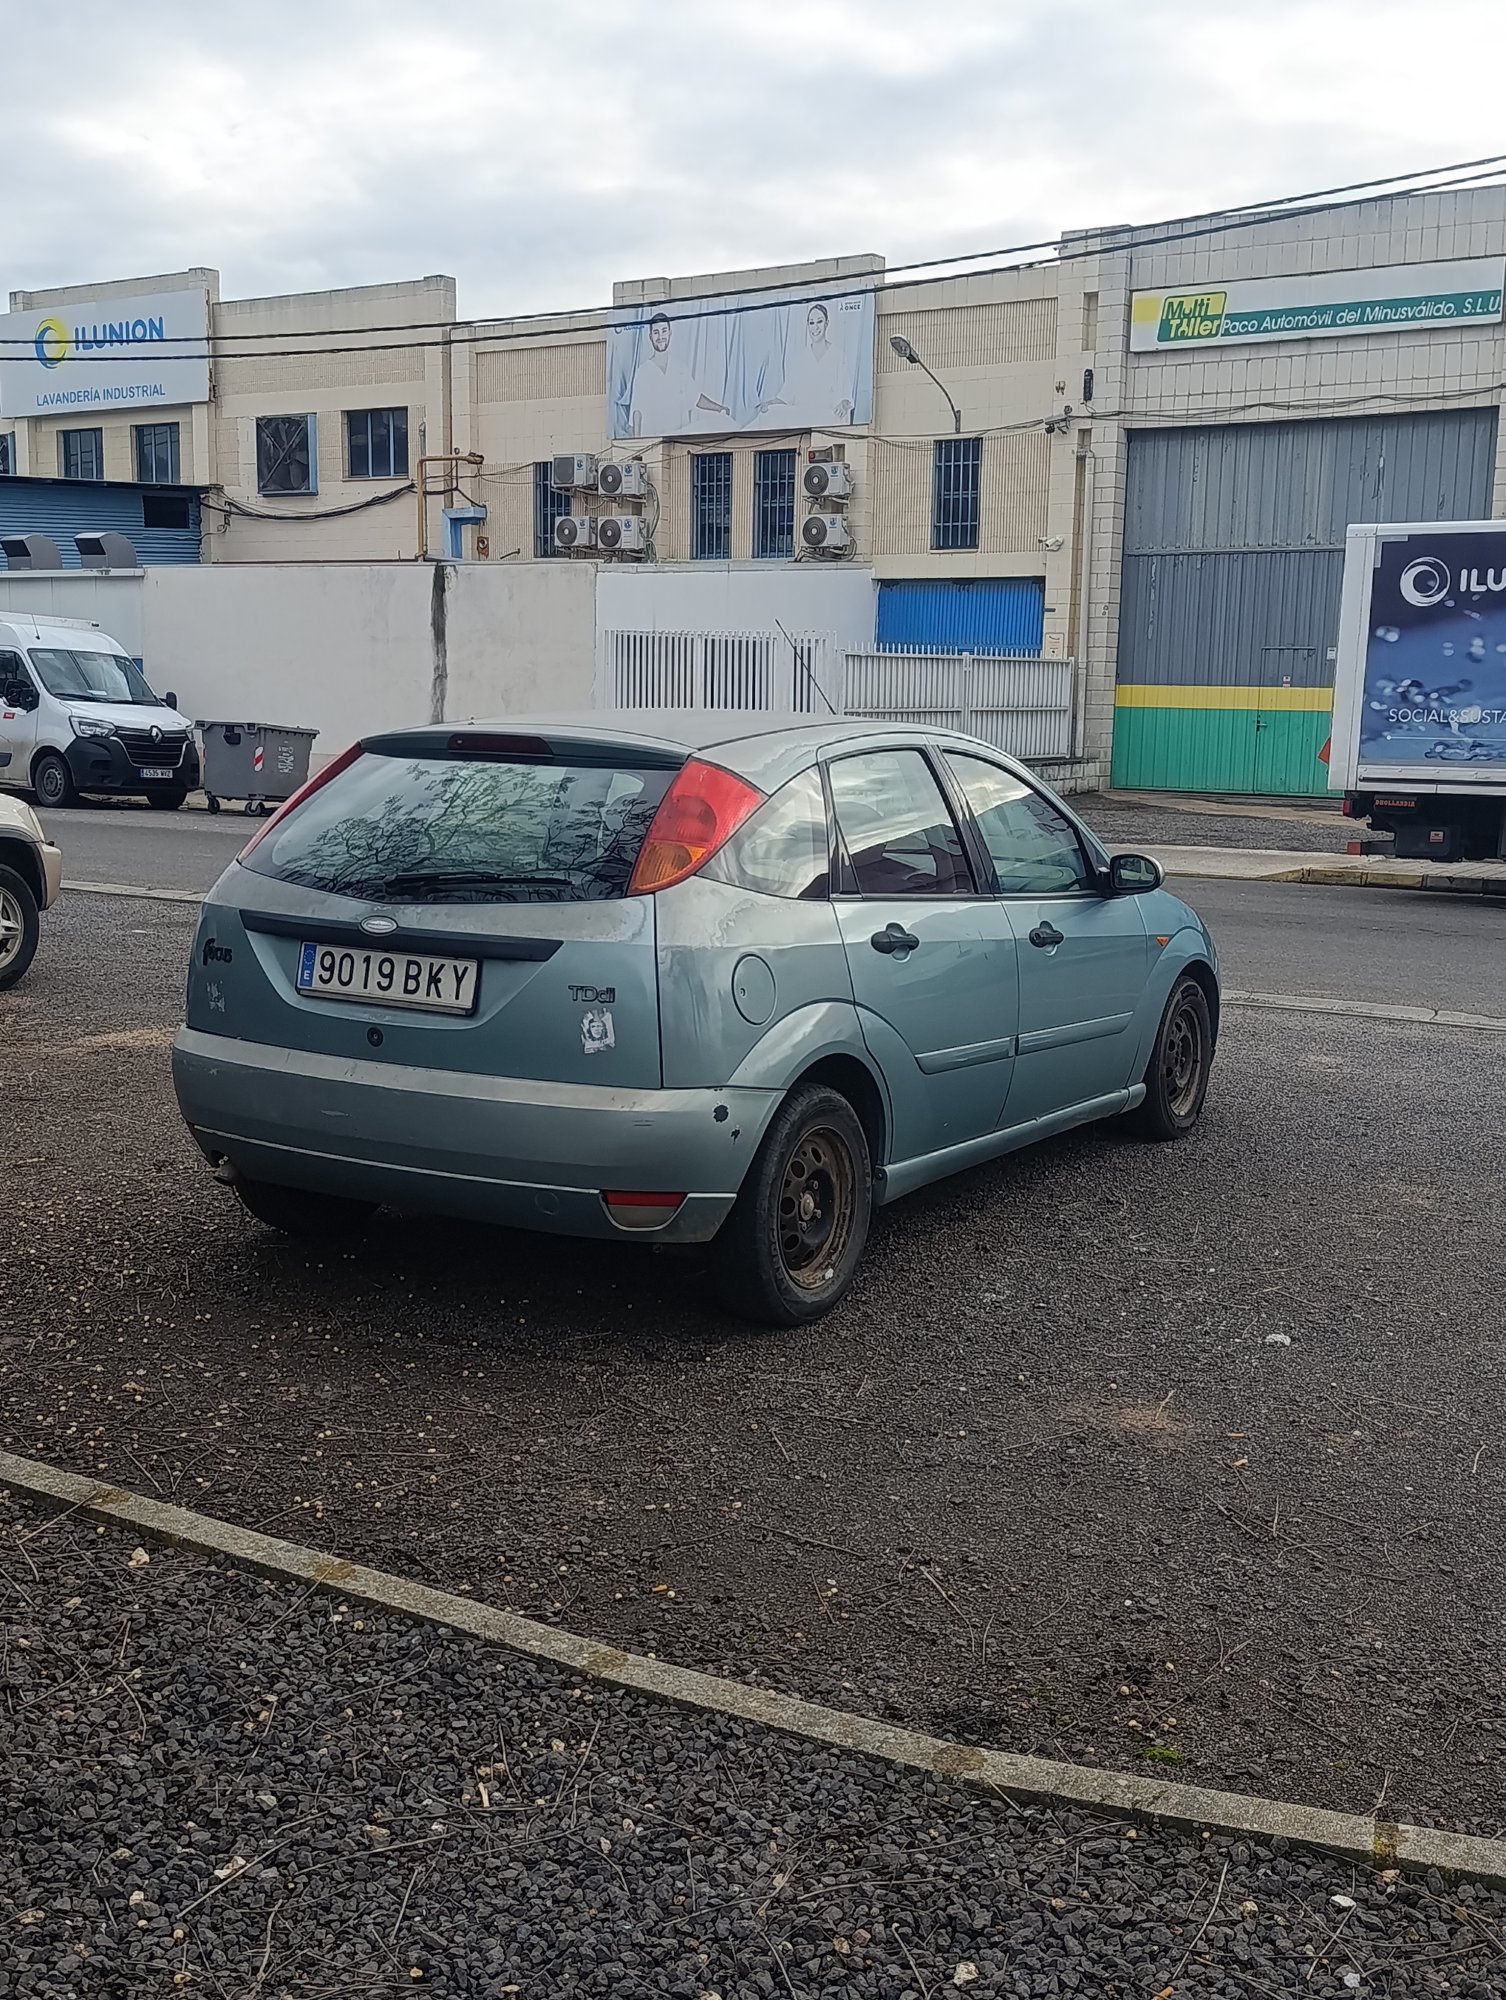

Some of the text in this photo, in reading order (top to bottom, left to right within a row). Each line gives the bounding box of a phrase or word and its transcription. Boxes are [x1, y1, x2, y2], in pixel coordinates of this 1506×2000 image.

[1163, 298, 1211, 319] Multi
[1221, 319, 1258, 334] Paco
[1260, 309, 1333, 331] Automóvil
[1336, 307, 1361, 324] del
[1363, 301, 1457, 322] Minusválido,
[74, 316, 164, 351] ILUNION
[1169, 318, 1221, 338] Taller
[37, 384, 166, 406] LAVANDERÍA INDUSTRIAL
[1460, 568, 1506, 592] ILU
[303, 970, 311, 980] E
[318, 951, 469, 1001] 9019 BKY
